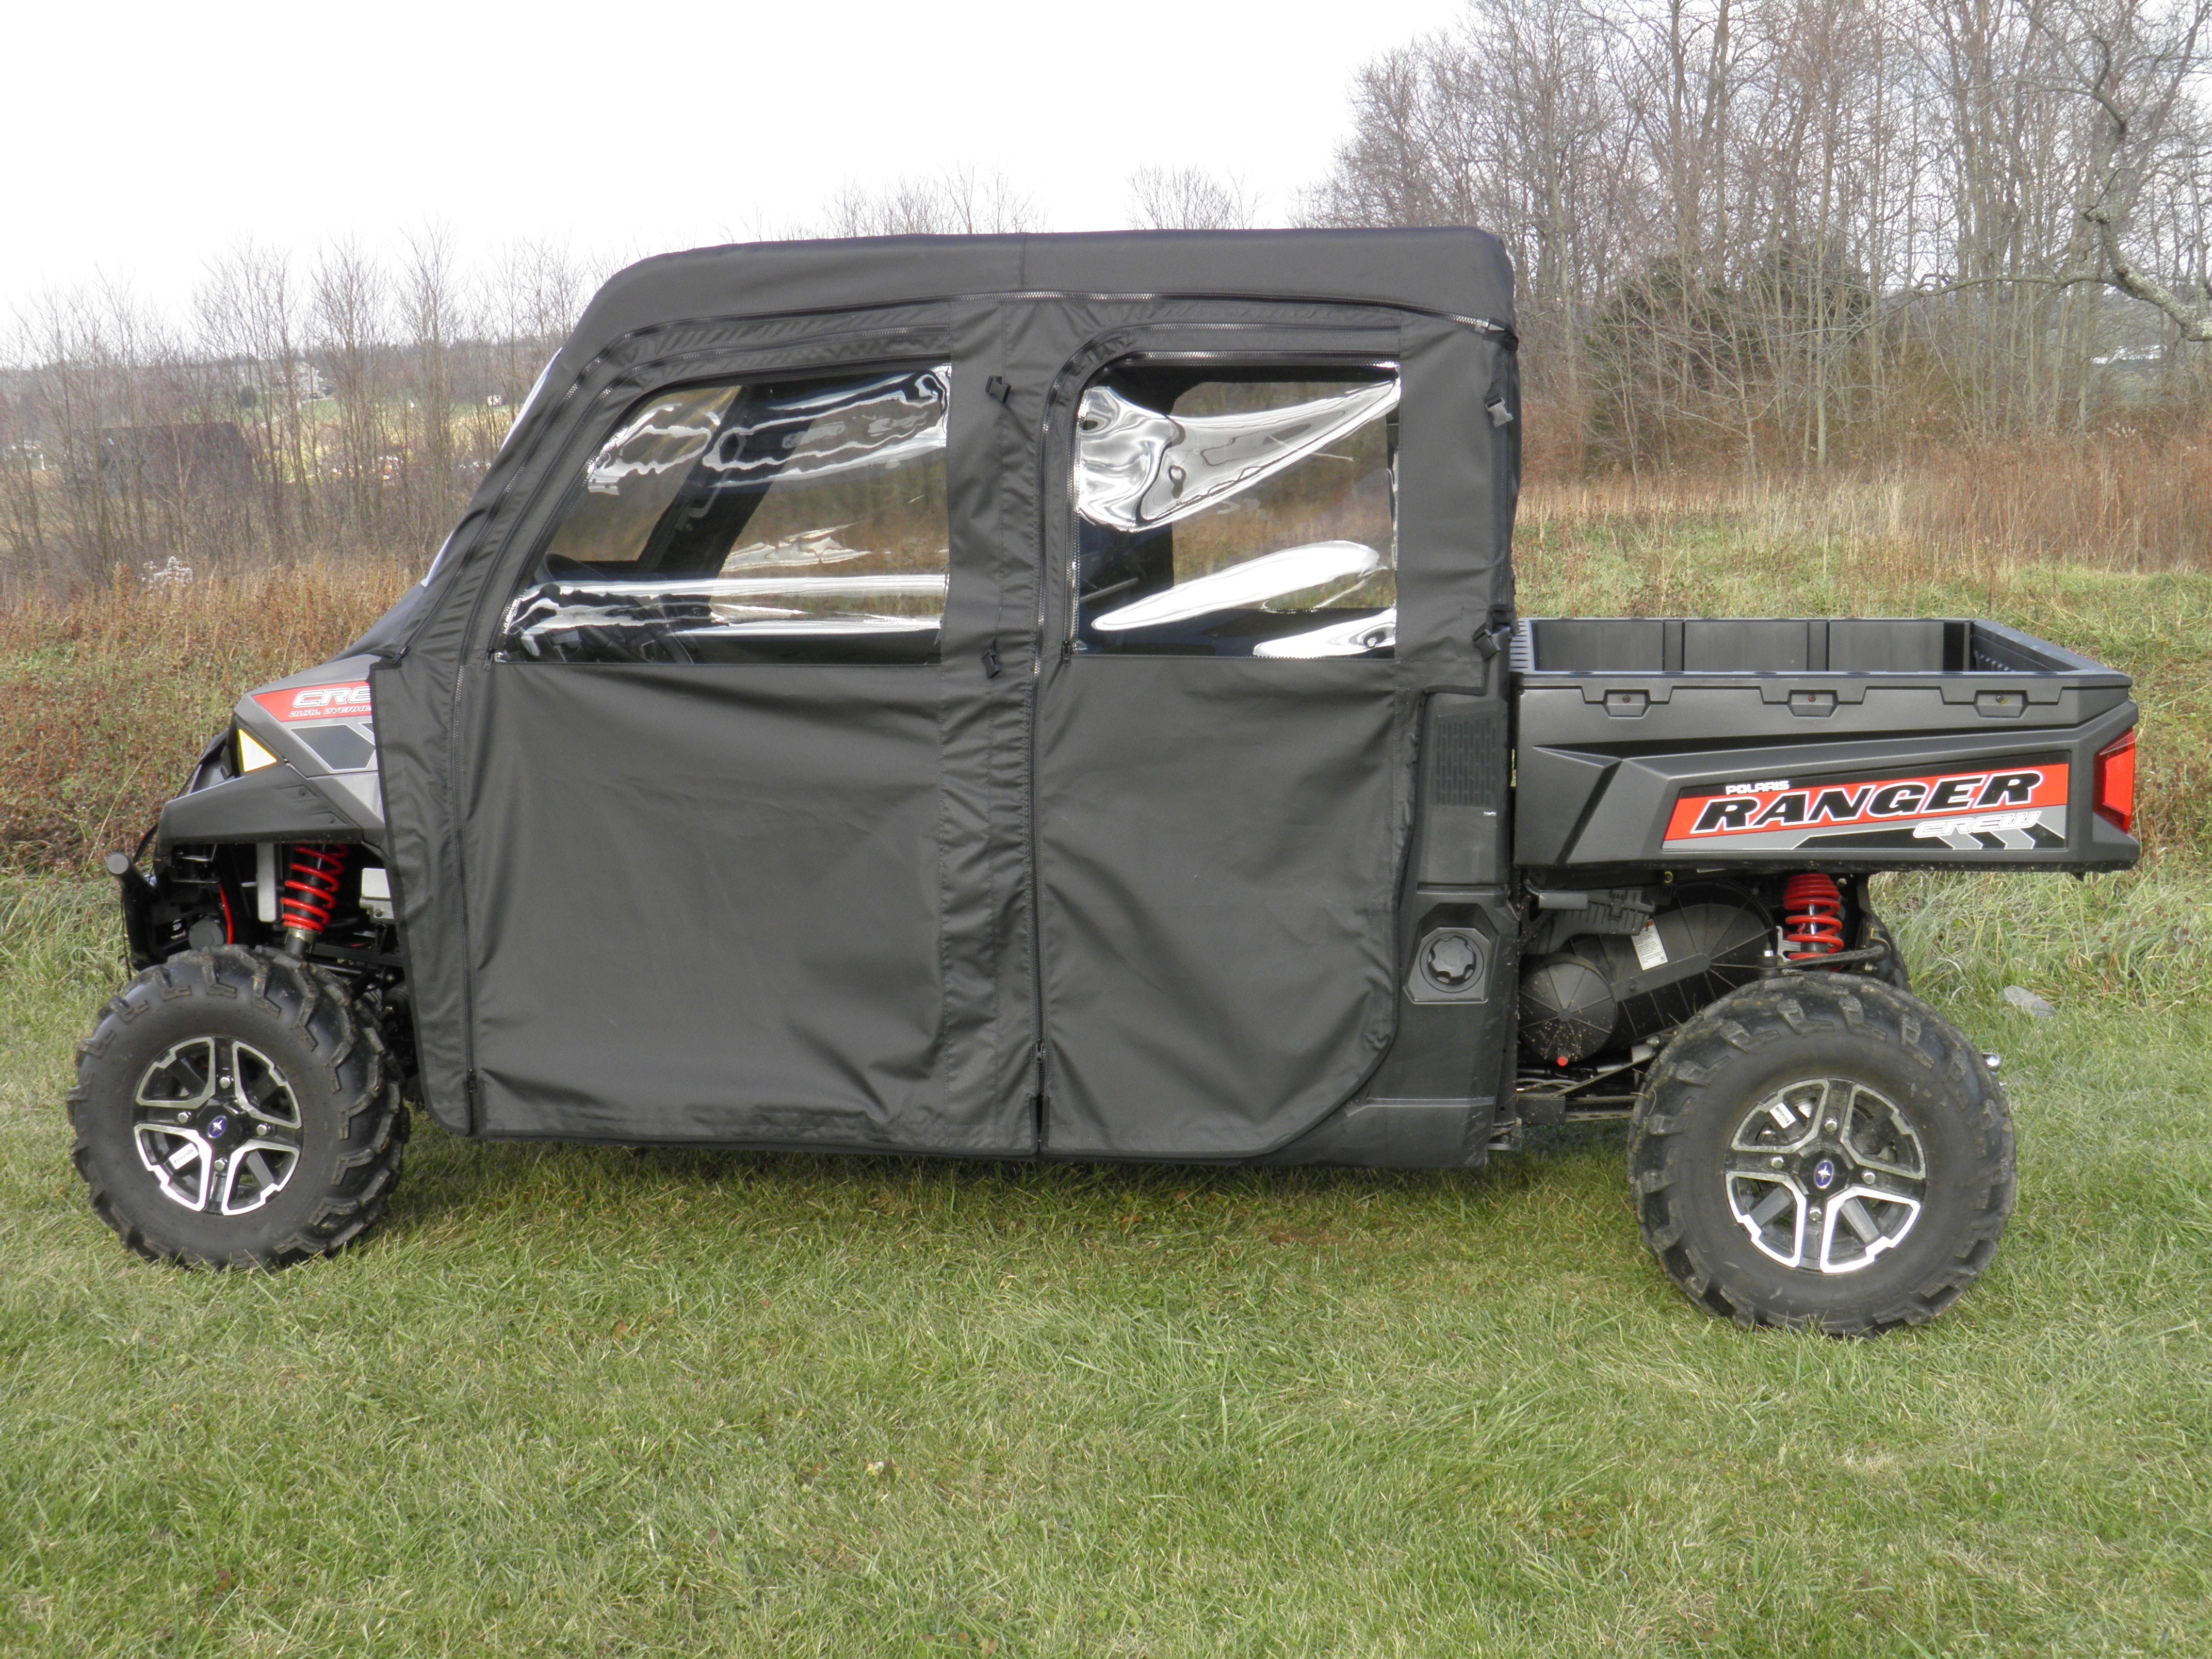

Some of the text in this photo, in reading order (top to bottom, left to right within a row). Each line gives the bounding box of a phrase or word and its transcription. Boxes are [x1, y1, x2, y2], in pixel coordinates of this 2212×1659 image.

[289, 709, 321, 718] DUAL
[1726, 780, 1790, 795] POLARIS
[1690, 770, 2043, 834] RANGER
[1913, 810, 2042, 838] CREW
